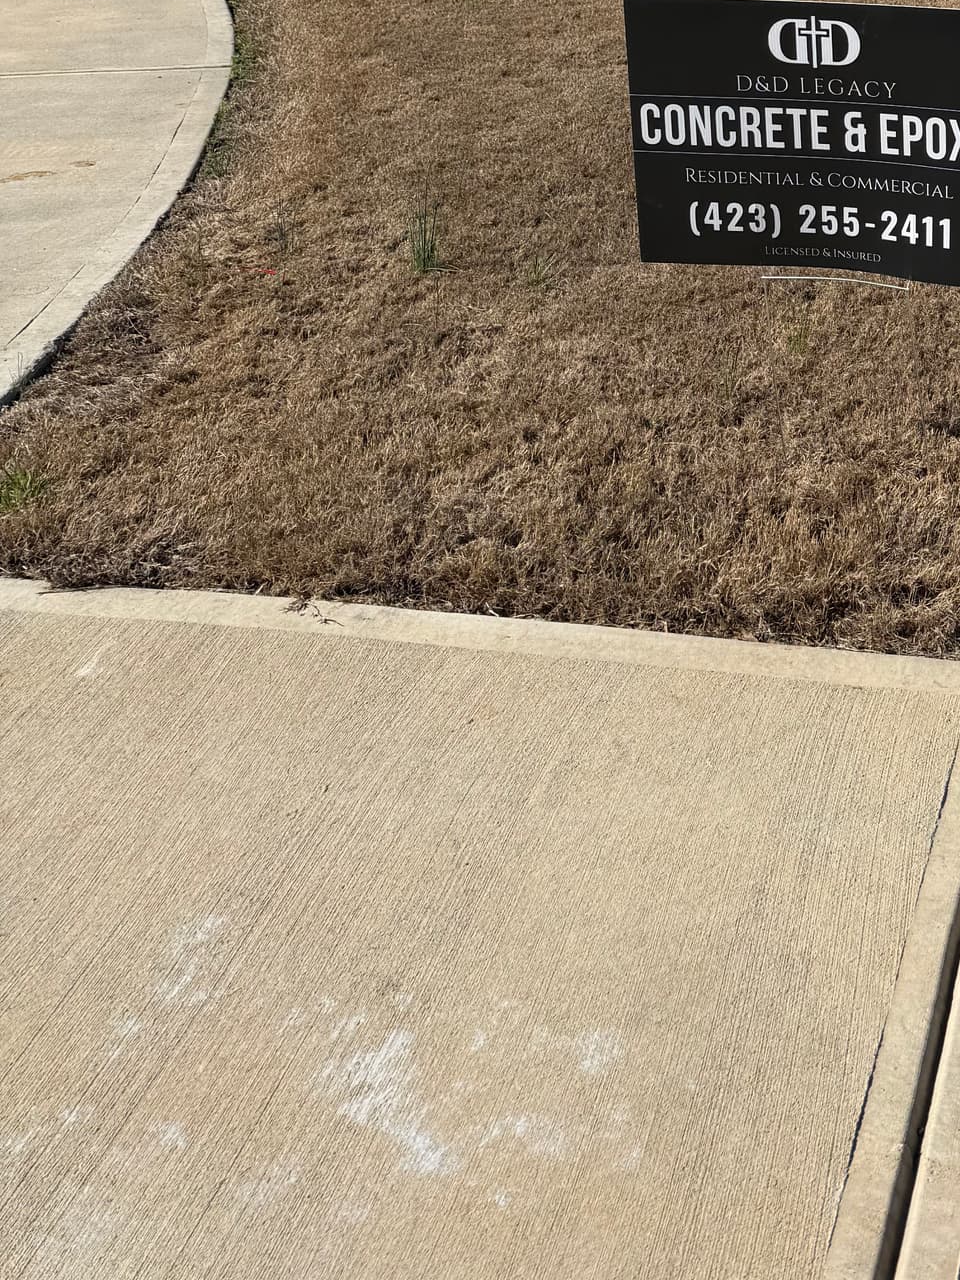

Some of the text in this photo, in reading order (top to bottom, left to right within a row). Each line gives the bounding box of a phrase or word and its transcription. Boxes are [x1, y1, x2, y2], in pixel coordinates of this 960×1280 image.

[736, 74, 897, 99] D&D LEGACY
[640, 102, 831, 151] CONCRETE
[843, 110, 867, 153] &
[685, 167, 955, 200] RESIDENTIAL & COMMERCIAL
[689, 200, 951, 250] (423) 255-2411
[765, 245, 882, 263] LICENSED & INSURED
